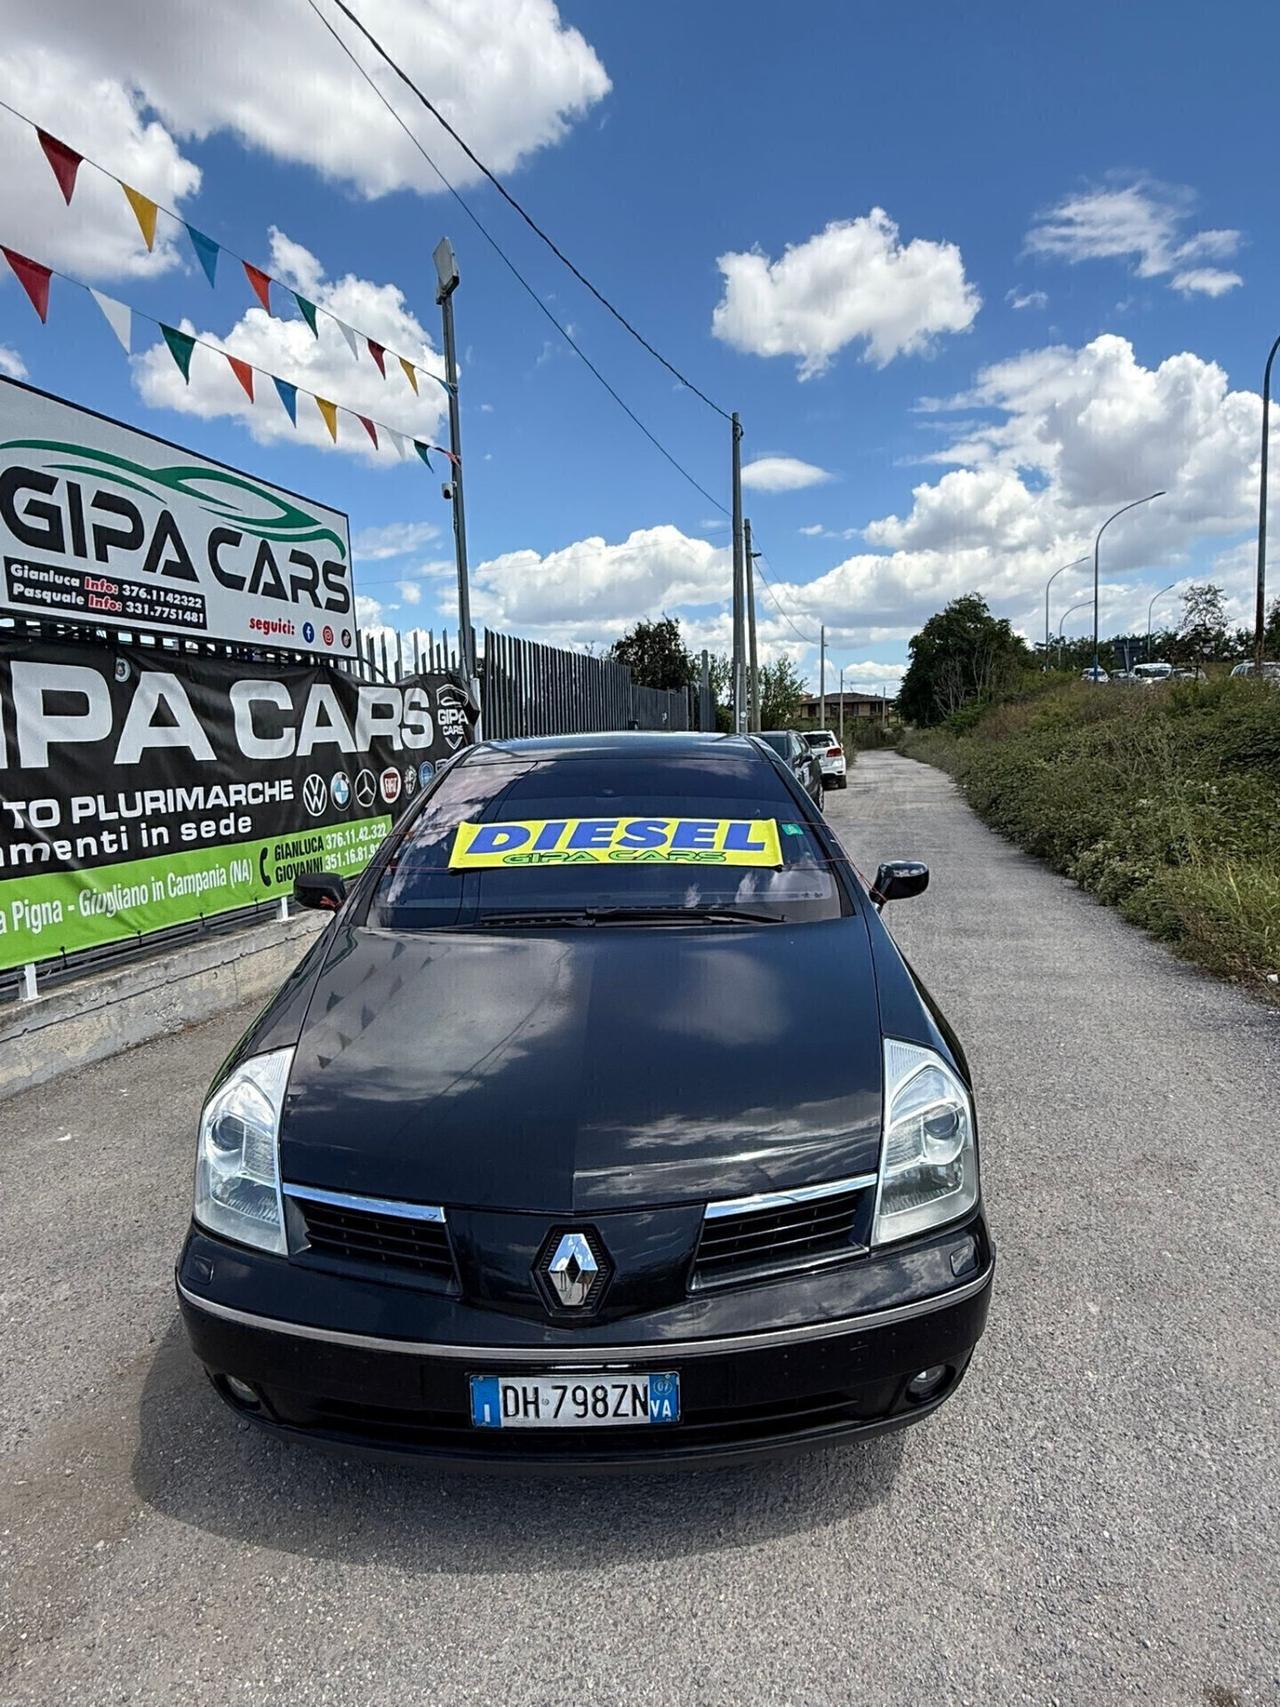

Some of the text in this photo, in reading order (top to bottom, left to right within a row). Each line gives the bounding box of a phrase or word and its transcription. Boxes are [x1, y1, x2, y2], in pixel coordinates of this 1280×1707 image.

[0, 465, 351, 614] GIPA CARS
[10, 563, 203, 609] Gianluca Info: 376.1142322
[12, 582, 205, 624] Pasquale Info: 331.7751481
[249, 617, 295, 635] seguici:
[0, 660, 434, 769] PA CARS
[437, 708, 469, 725] GIPA
[442, 725, 464, 736] CARS
[2, 798, 61, 829] TO
[70, 778, 294, 825] PLURIMARCHE
[140, 820, 172, 849] in
[180, 813, 253, 840] sede
[274, 835, 325, 862] GIANLUCA
[465, 819, 766, 855] DIESEL
[275, 856, 323, 884] GIOVANNI
[502, 850, 727, 864] GIPA CARS
[11, 898, 63, 935] Pigna
[151, 875, 165, 902] in
[167, 863, 227, 898] Campania
[229, 858, 253, 889] (NA)
[650, 1399, 672, 1417] VA
